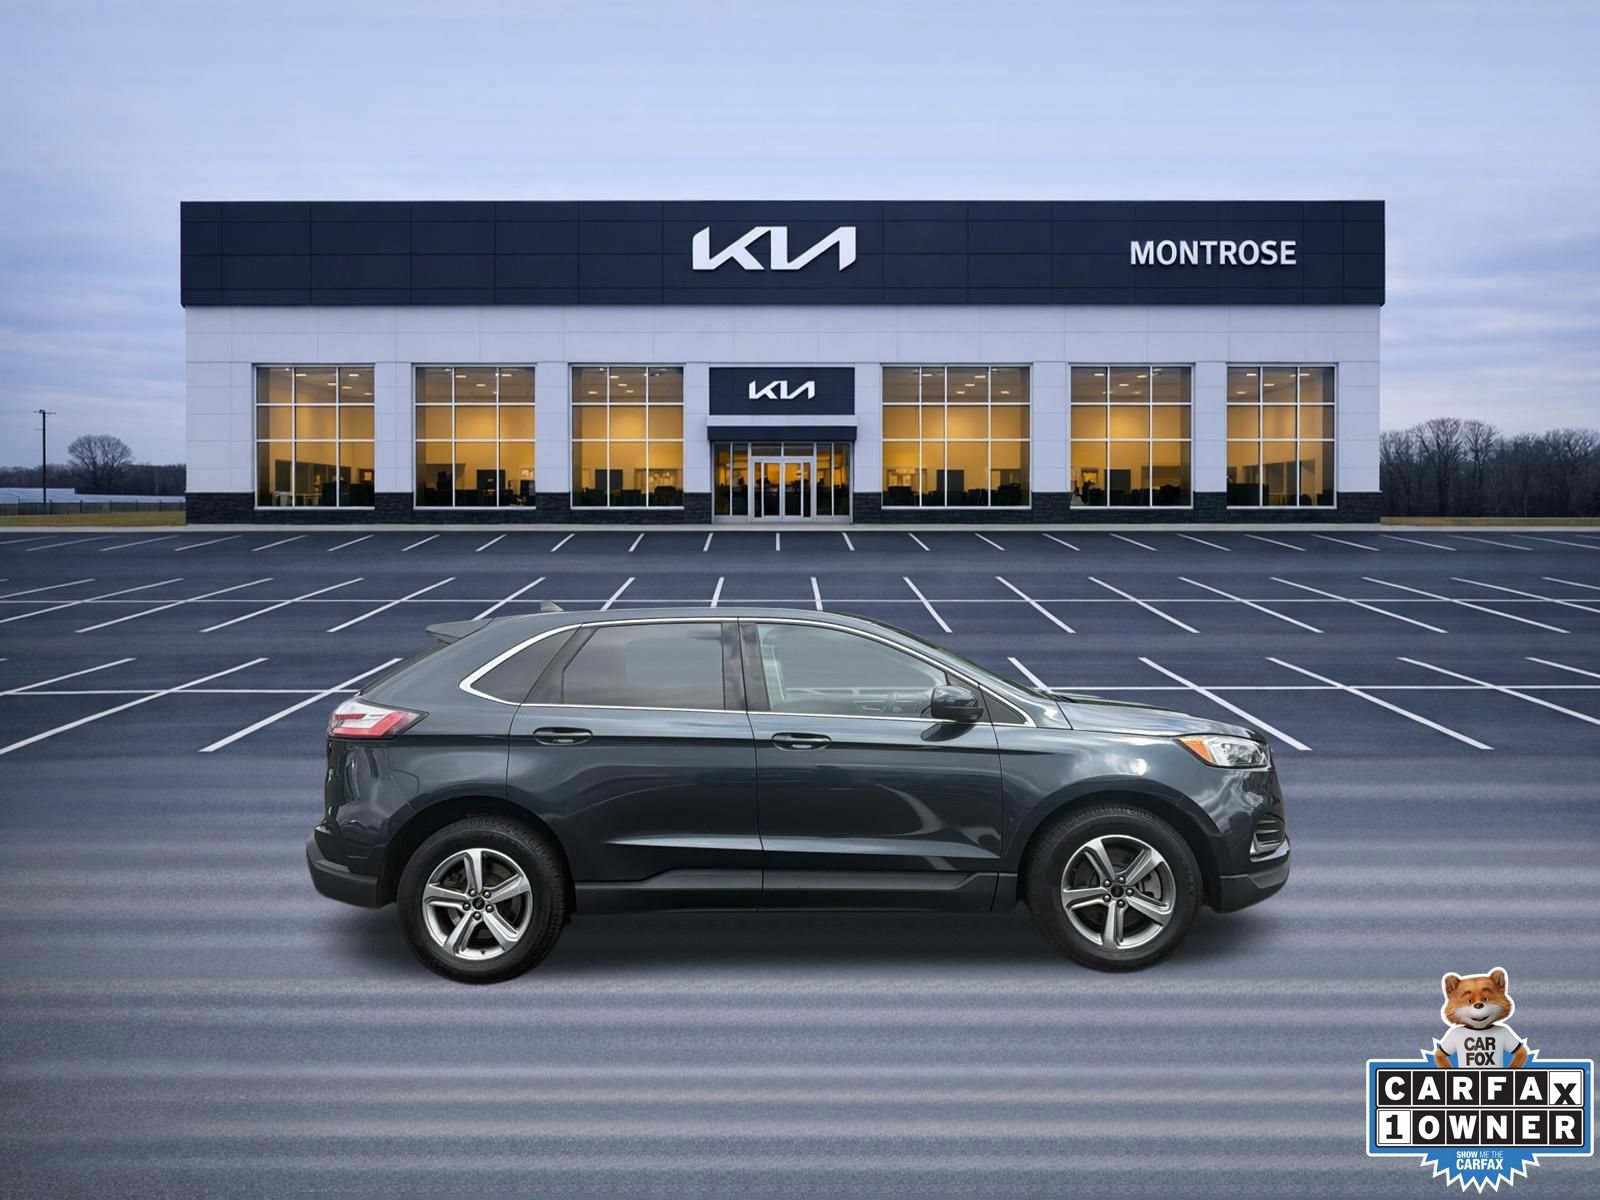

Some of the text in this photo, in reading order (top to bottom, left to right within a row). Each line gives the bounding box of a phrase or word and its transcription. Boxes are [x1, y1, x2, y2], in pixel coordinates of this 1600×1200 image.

[692, 226, 856, 271] KIA
[1130, 240, 1296, 265] MONTROSE
[749, 380, 815, 400] KIA
